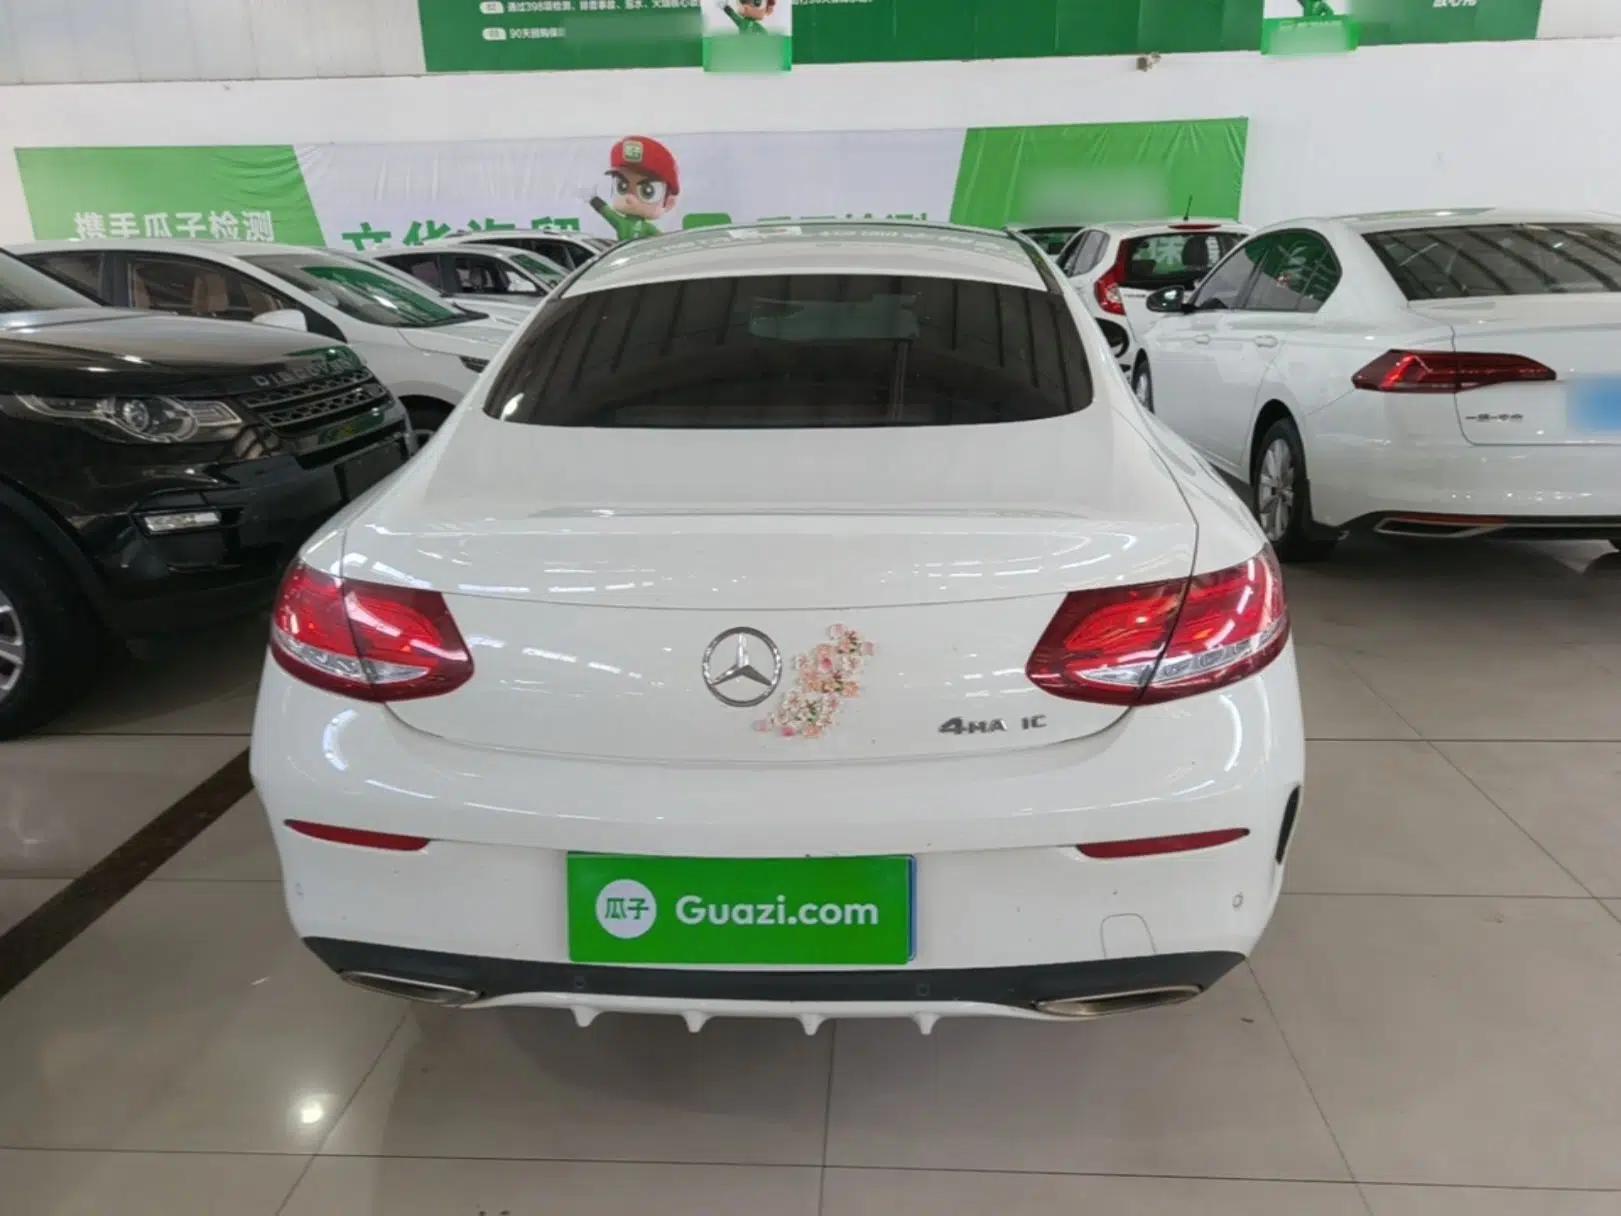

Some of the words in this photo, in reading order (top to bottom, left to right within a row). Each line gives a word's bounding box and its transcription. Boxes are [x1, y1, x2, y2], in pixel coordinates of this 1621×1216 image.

[74, 210, 275, 242] 携手瓜子检测
[604, 896, 650, 921] 瓜子
[675, 894, 880, 926] Guazi.com
